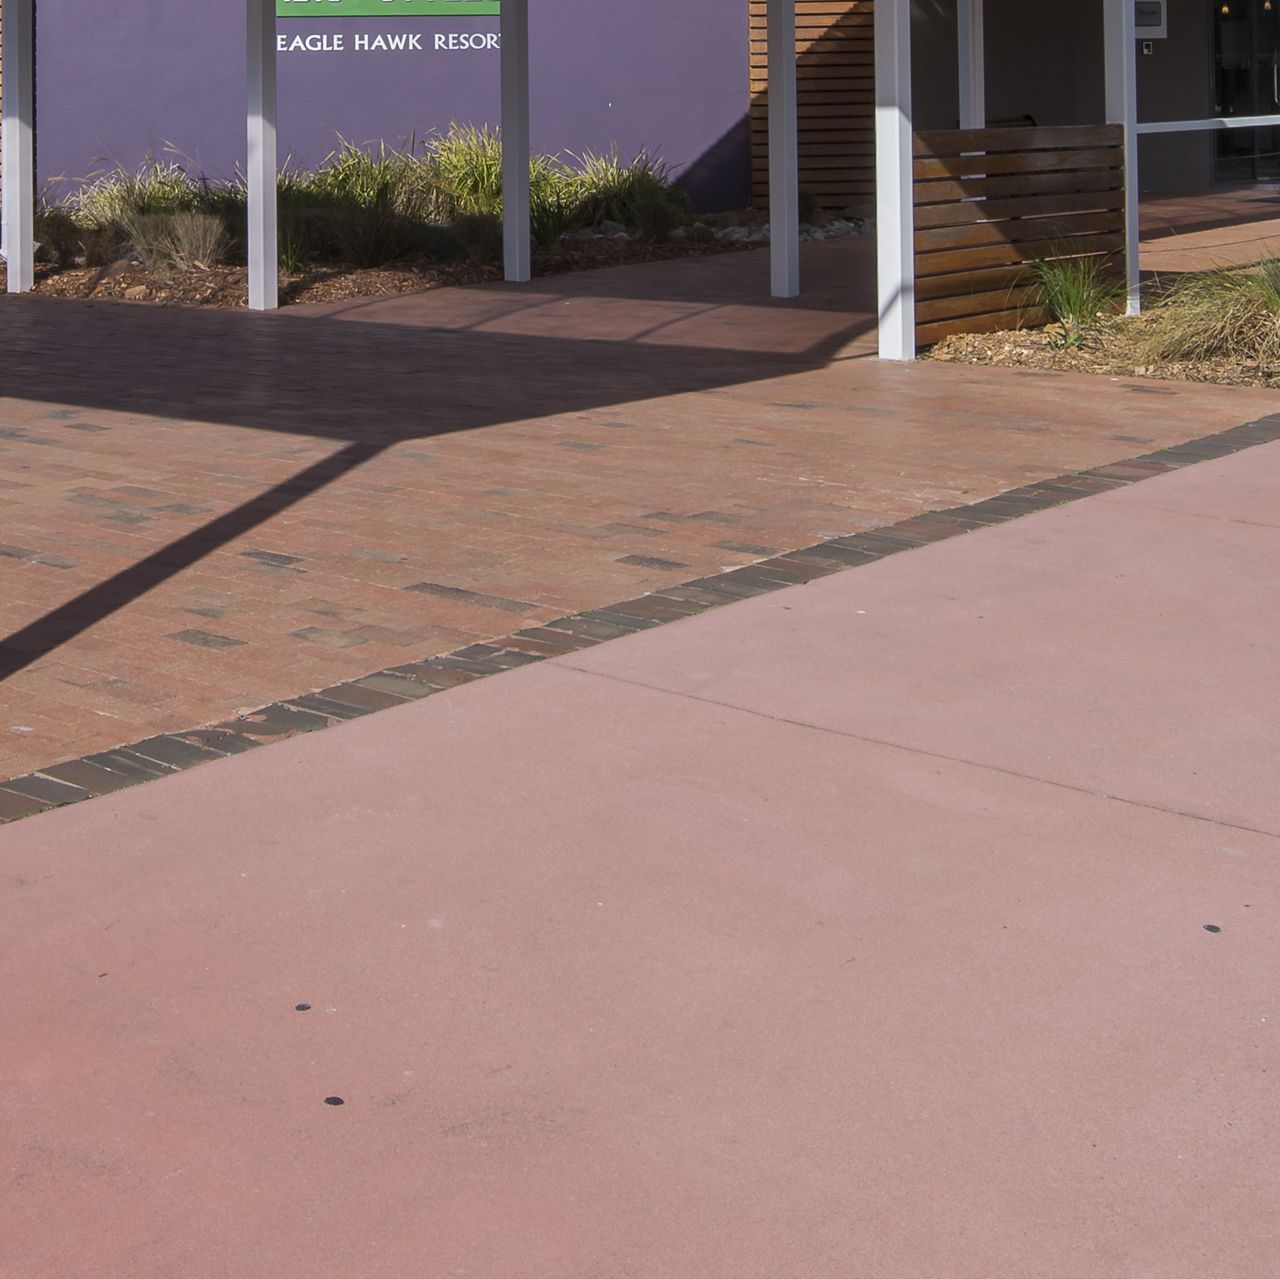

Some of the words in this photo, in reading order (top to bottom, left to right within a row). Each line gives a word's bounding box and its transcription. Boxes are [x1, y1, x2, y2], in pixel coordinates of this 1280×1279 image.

[276, 34, 344, 51] EAGLE
[354, 33, 422, 51] HAWK
[434, 33, 501, 50] RESOR
